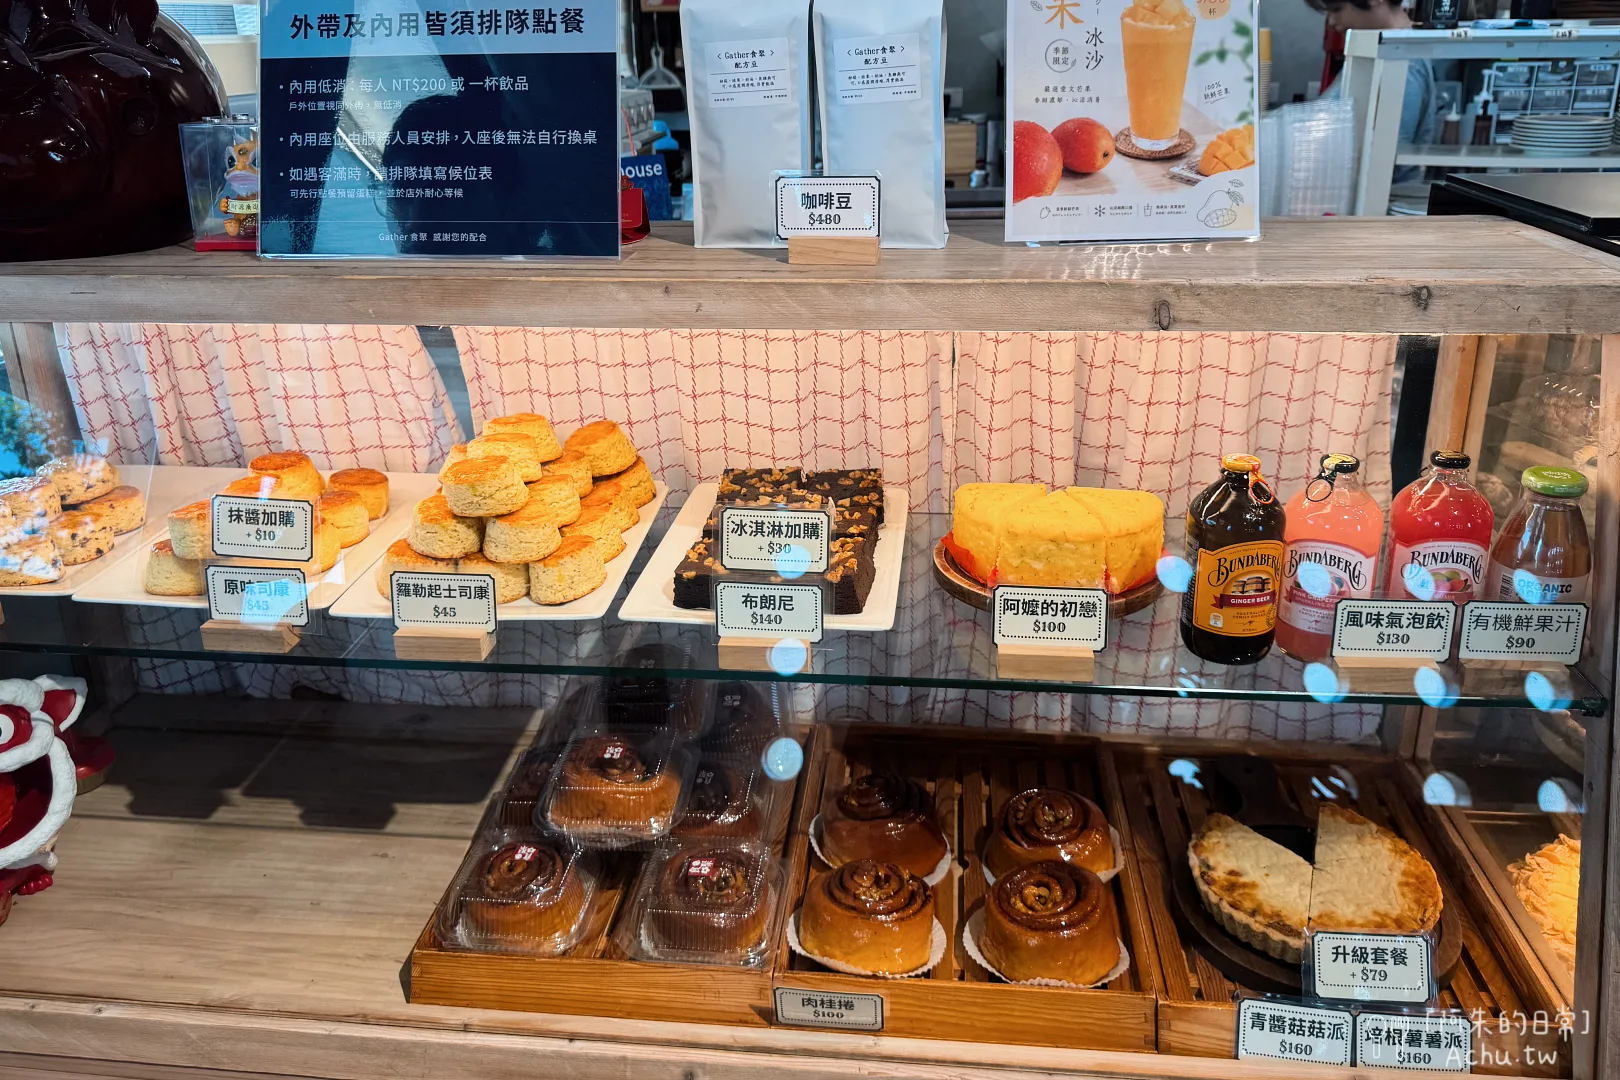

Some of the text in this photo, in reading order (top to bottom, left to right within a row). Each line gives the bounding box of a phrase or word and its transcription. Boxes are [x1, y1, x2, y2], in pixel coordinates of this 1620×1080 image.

[290, 8, 585, 40] 外帶及內用皆須排隊點餐
[1085, 27, 1104, 71] 冰沙
[734, 61, 759, 69] 配方豆
[864, 57, 888, 65] 配方豆
[392, 78, 446, 92] NT$200
[451, 76, 465, 91] 或
[469, 76, 529, 91] 一杯飲品
[800, 192, 852, 211] 咖啡豆
[808, 212, 841, 226] $480
[378, 232, 409, 242] Gather
[432, 232, 488, 242] 感謝您的配合
[227, 506, 296, 528] 抹醬加購
[730, 519, 820, 540] 冰淇淋加購
[224, 579, 290, 597] 原味司康
[397, 582, 490, 600] 羅勒起士司康
[1517, 579, 1572, 593] ORGANIC
[741, 593, 794, 611] 布朗尼
[1002, 598, 1098, 618] 阿嬤的初戀
[433, 605, 457, 618] $45
[751, 612, 782, 625] $140
[1033, 619, 1066, 633] $100
[1344, 610, 1445, 630] 風味氣泡飲
[1472, 612, 1576, 633] 有機鮮果汁
[1376, 632, 1410, 645] $130
[1505, 635, 1535, 650] $90
[1331, 945, 1408, 967] 升級套餐
[1360, 967, 1388, 982] $79
[802, 996, 855, 1010] 肉桂捲
[813, 1009, 844, 1018] $100
[1249, 1012, 1346, 1041] 青醬菇菇派
[1279, 1039, 1313, 1056] $160
[1397, 1052, 1432, 1066] $160
